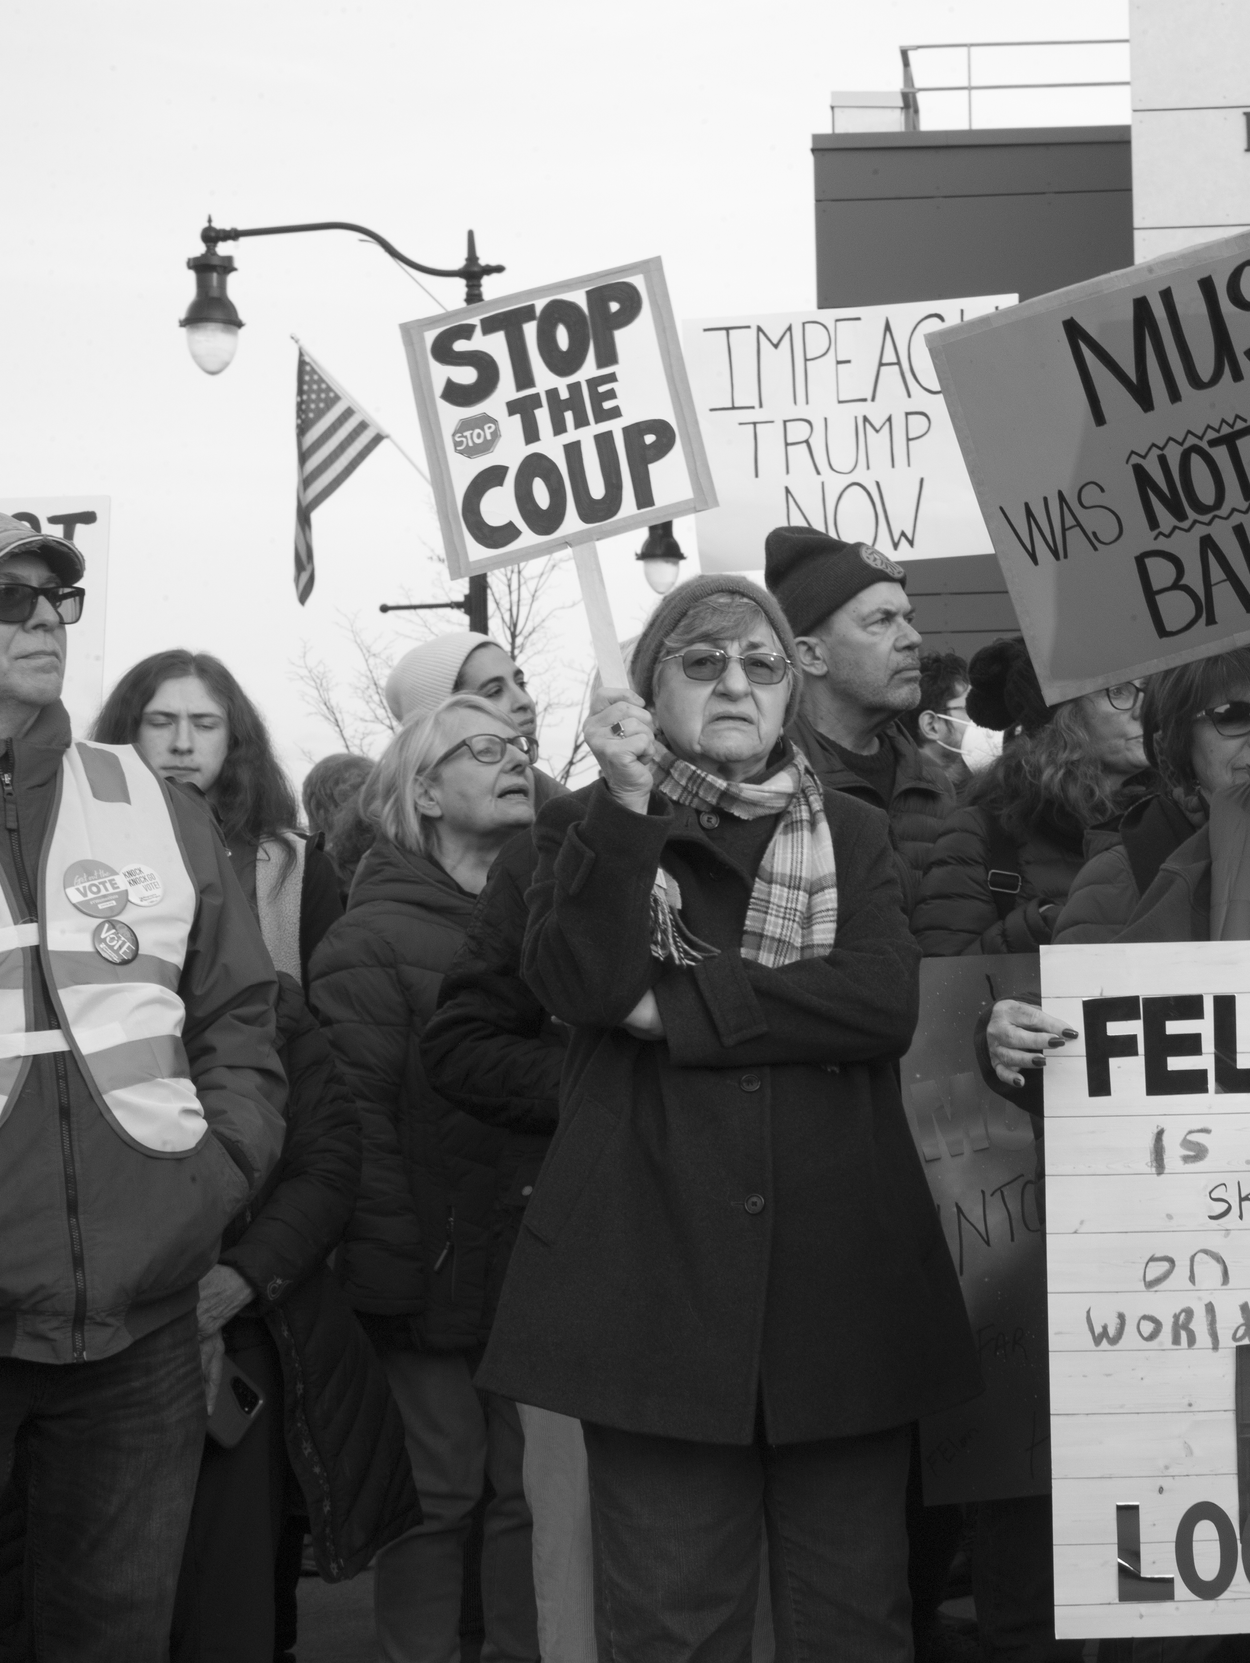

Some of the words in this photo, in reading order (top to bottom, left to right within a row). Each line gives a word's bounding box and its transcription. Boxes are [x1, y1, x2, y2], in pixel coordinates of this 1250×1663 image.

[430, 281, 643, 408] STOP
[702, 304, 999, 412] IMPEAC
[454, 423, 496, 450] STOP
[505, 371, 623, 446] THE
[738, 410, 932, 478] TRUMP
[461, 418, 677, 550] COUP
[784, 476, 925, 551] NOW
[999, 481, 1124, 567] WAS
[75, 878, 120, 898] VOTE
[122, 867, 145, 879] KNOCK
[127, 875, 149, 888] KNOCK
[146, 872, 157, 882] GO
[1143, 1248, 1230, 1290] on
